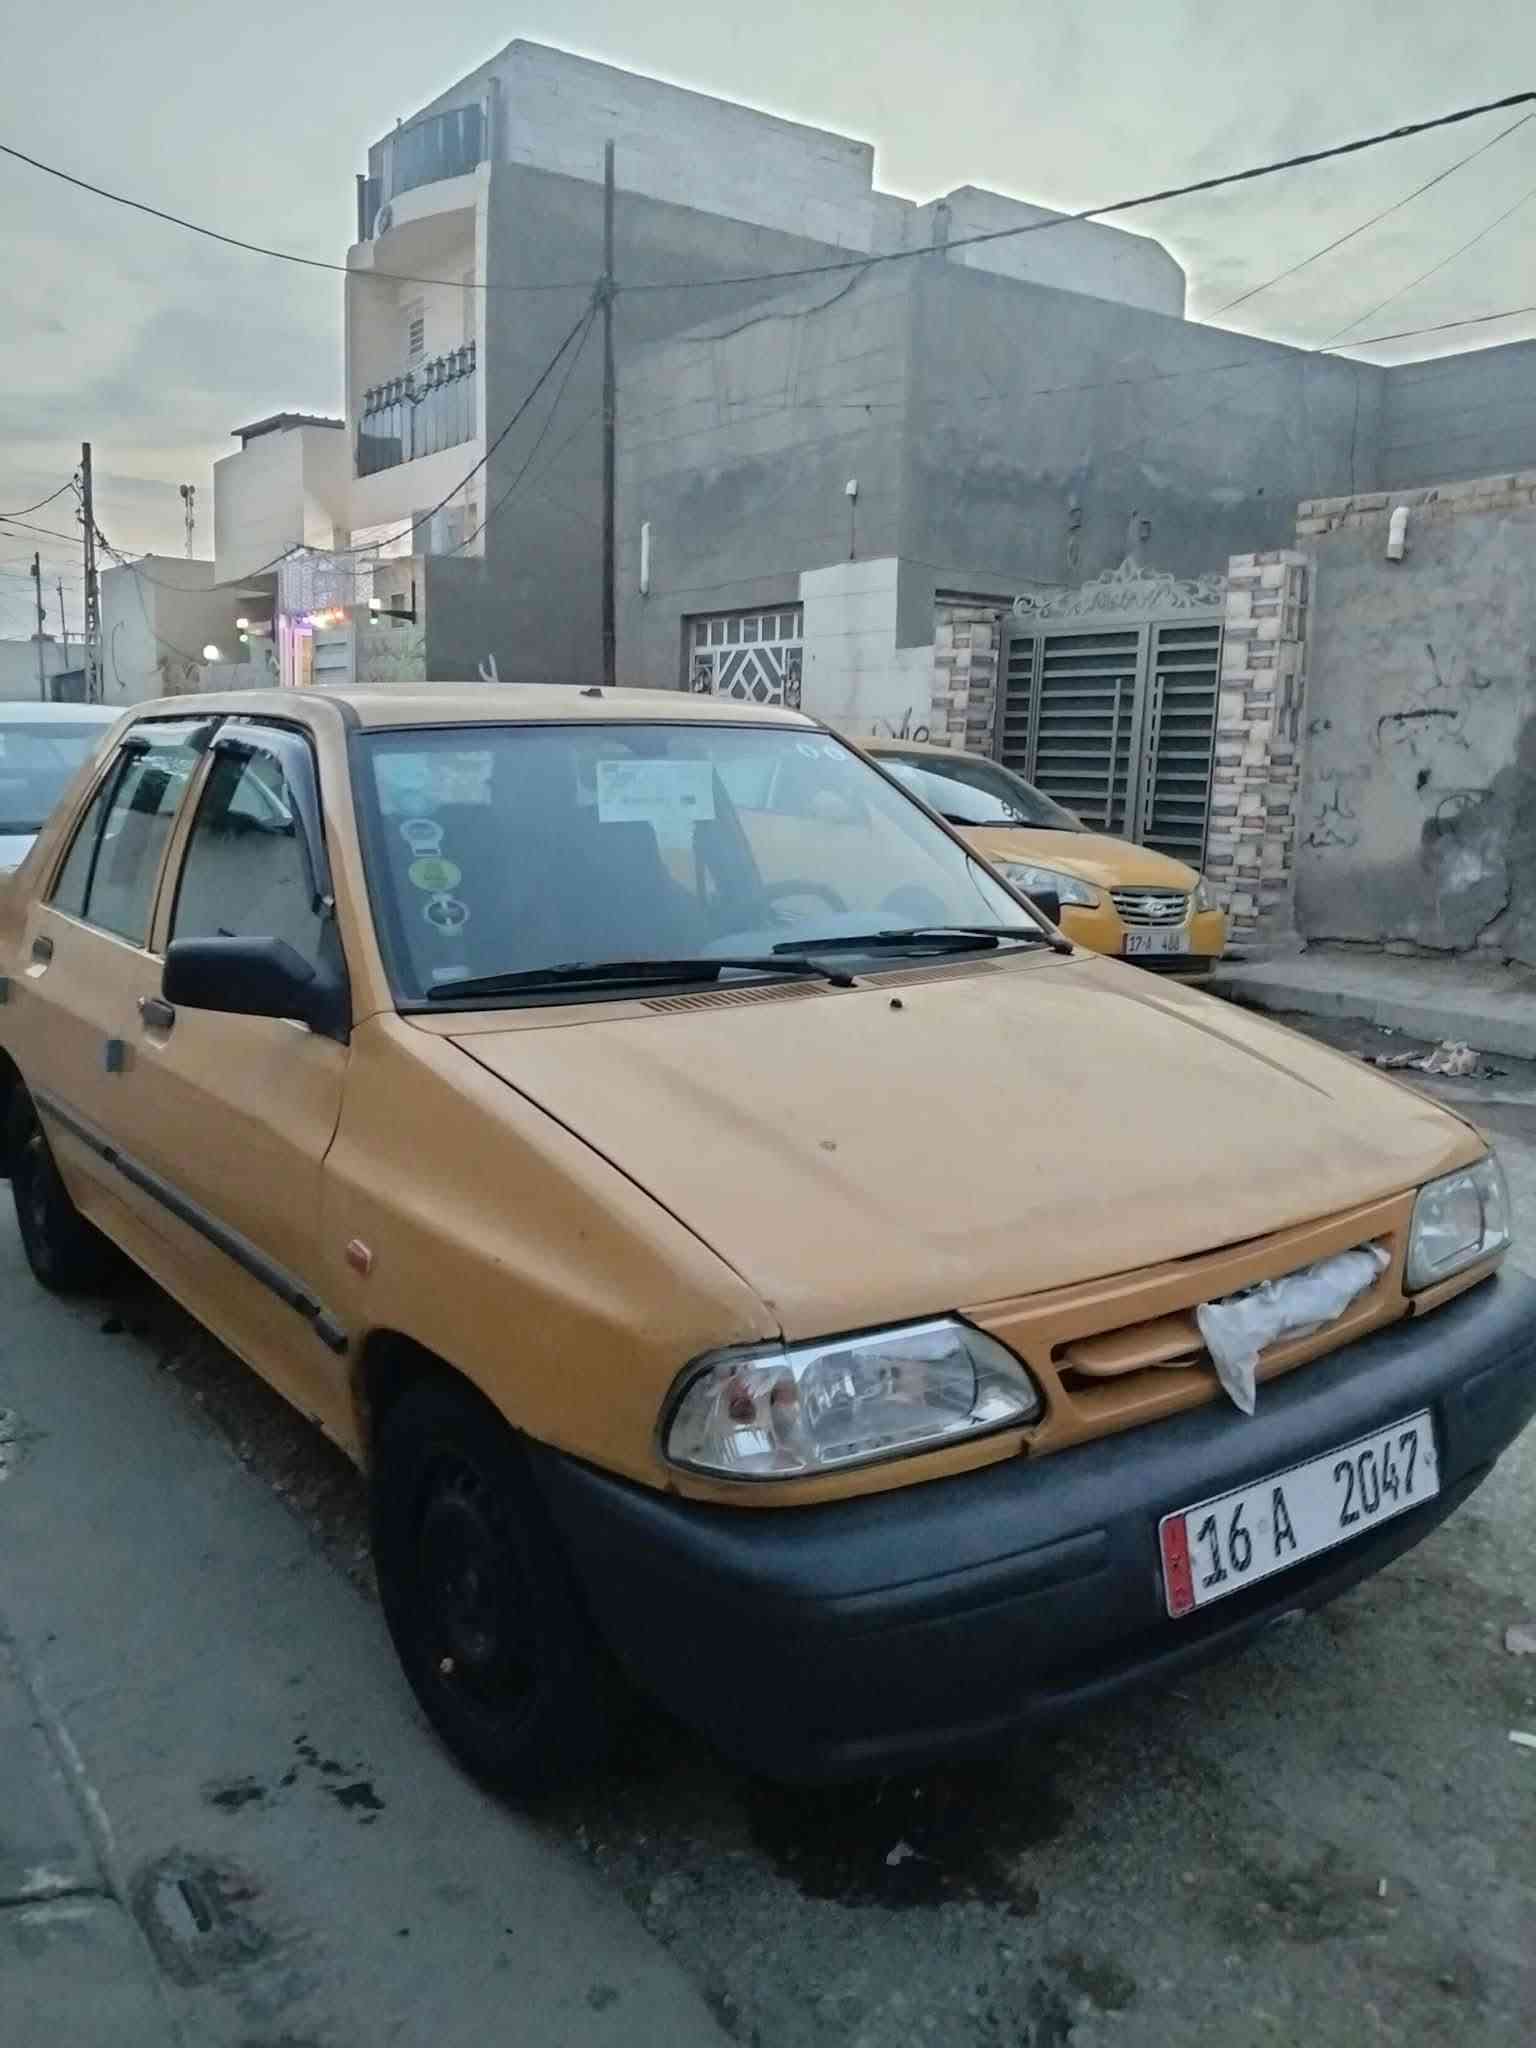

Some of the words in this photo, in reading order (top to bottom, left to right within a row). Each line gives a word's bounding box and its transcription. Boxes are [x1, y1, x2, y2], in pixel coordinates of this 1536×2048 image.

[1198, 1502, 1251, 1588] 16
[1272, 1486, 1297, 1556] A
[1333, 1430, 1418, 1528] 2047
